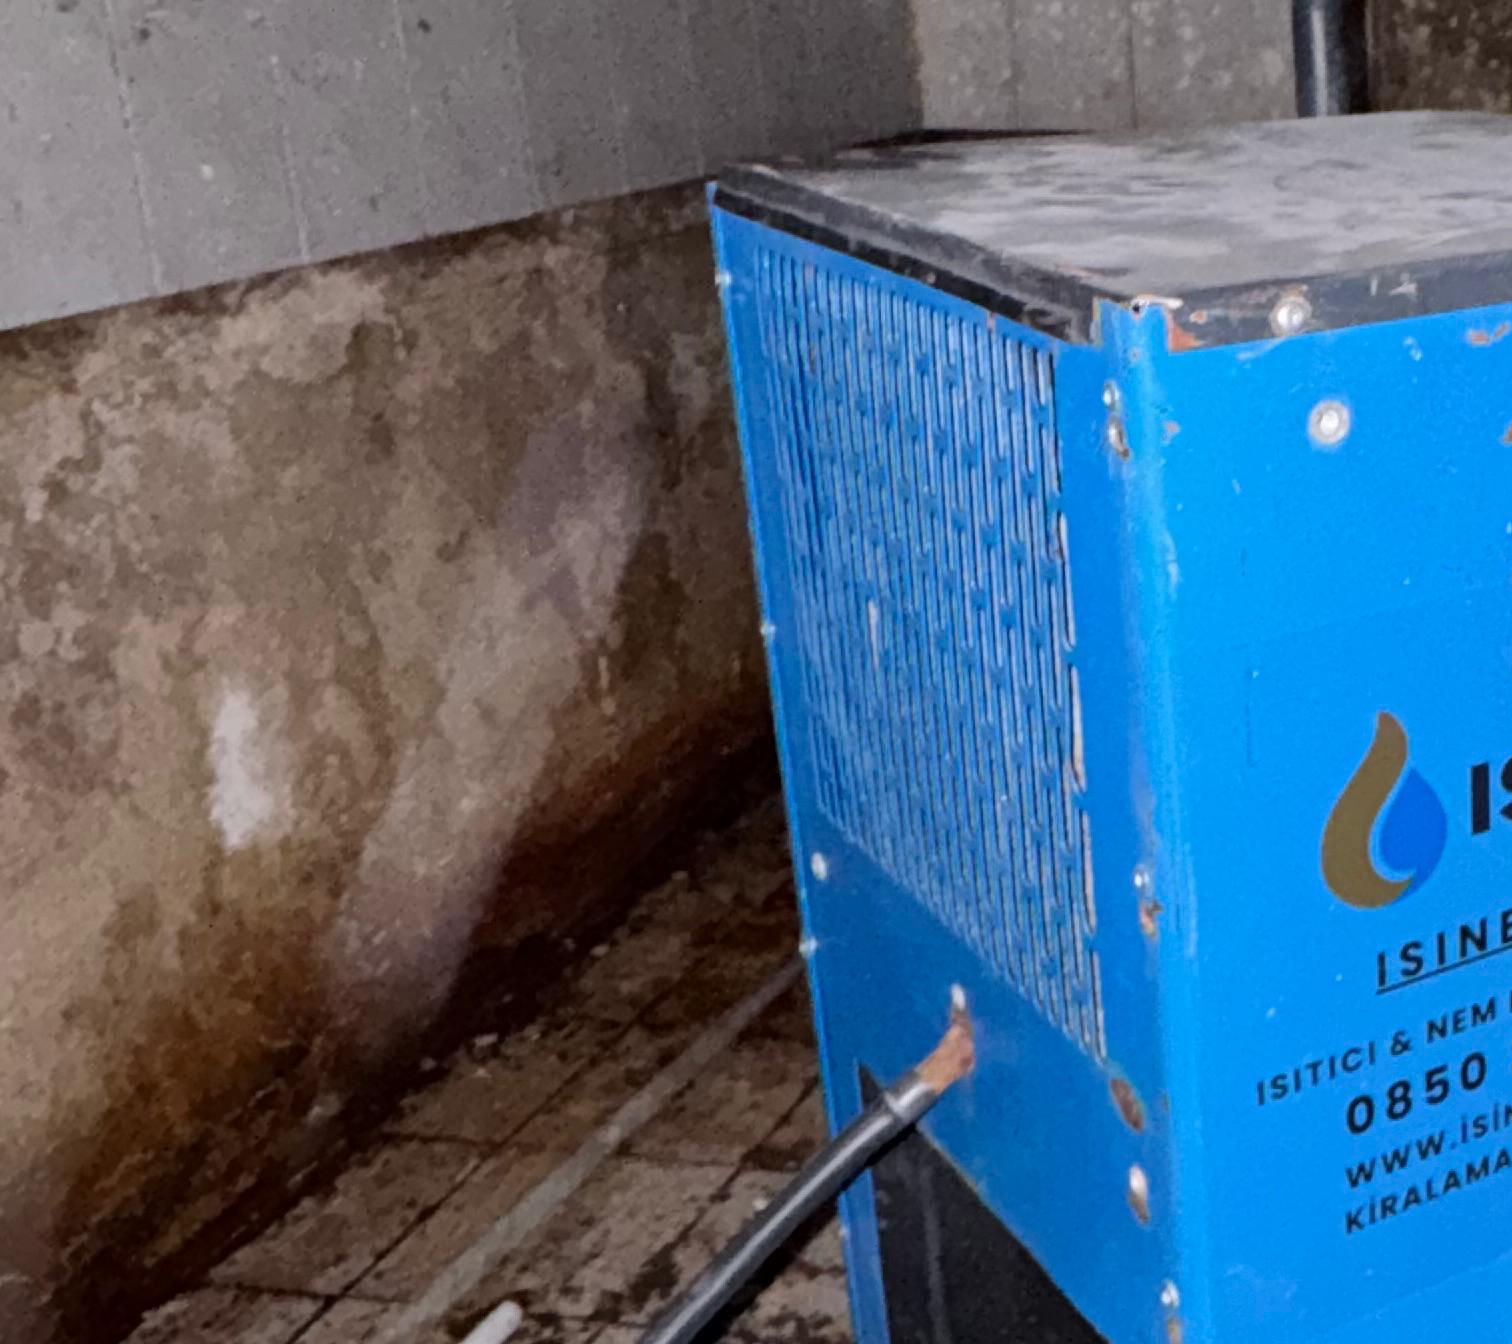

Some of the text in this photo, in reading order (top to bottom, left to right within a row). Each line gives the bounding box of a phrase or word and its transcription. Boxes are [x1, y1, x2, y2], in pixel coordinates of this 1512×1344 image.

[1256, 1040, 1376, 1106] ISITICI
[1390, 1029, 1413, 1057] &
[1426, 996, 1496, 1044] NEM
[1345, 1052, 1488, 1135] 0850
[1344, 1148, 1512, 1234] KİRALAMA
